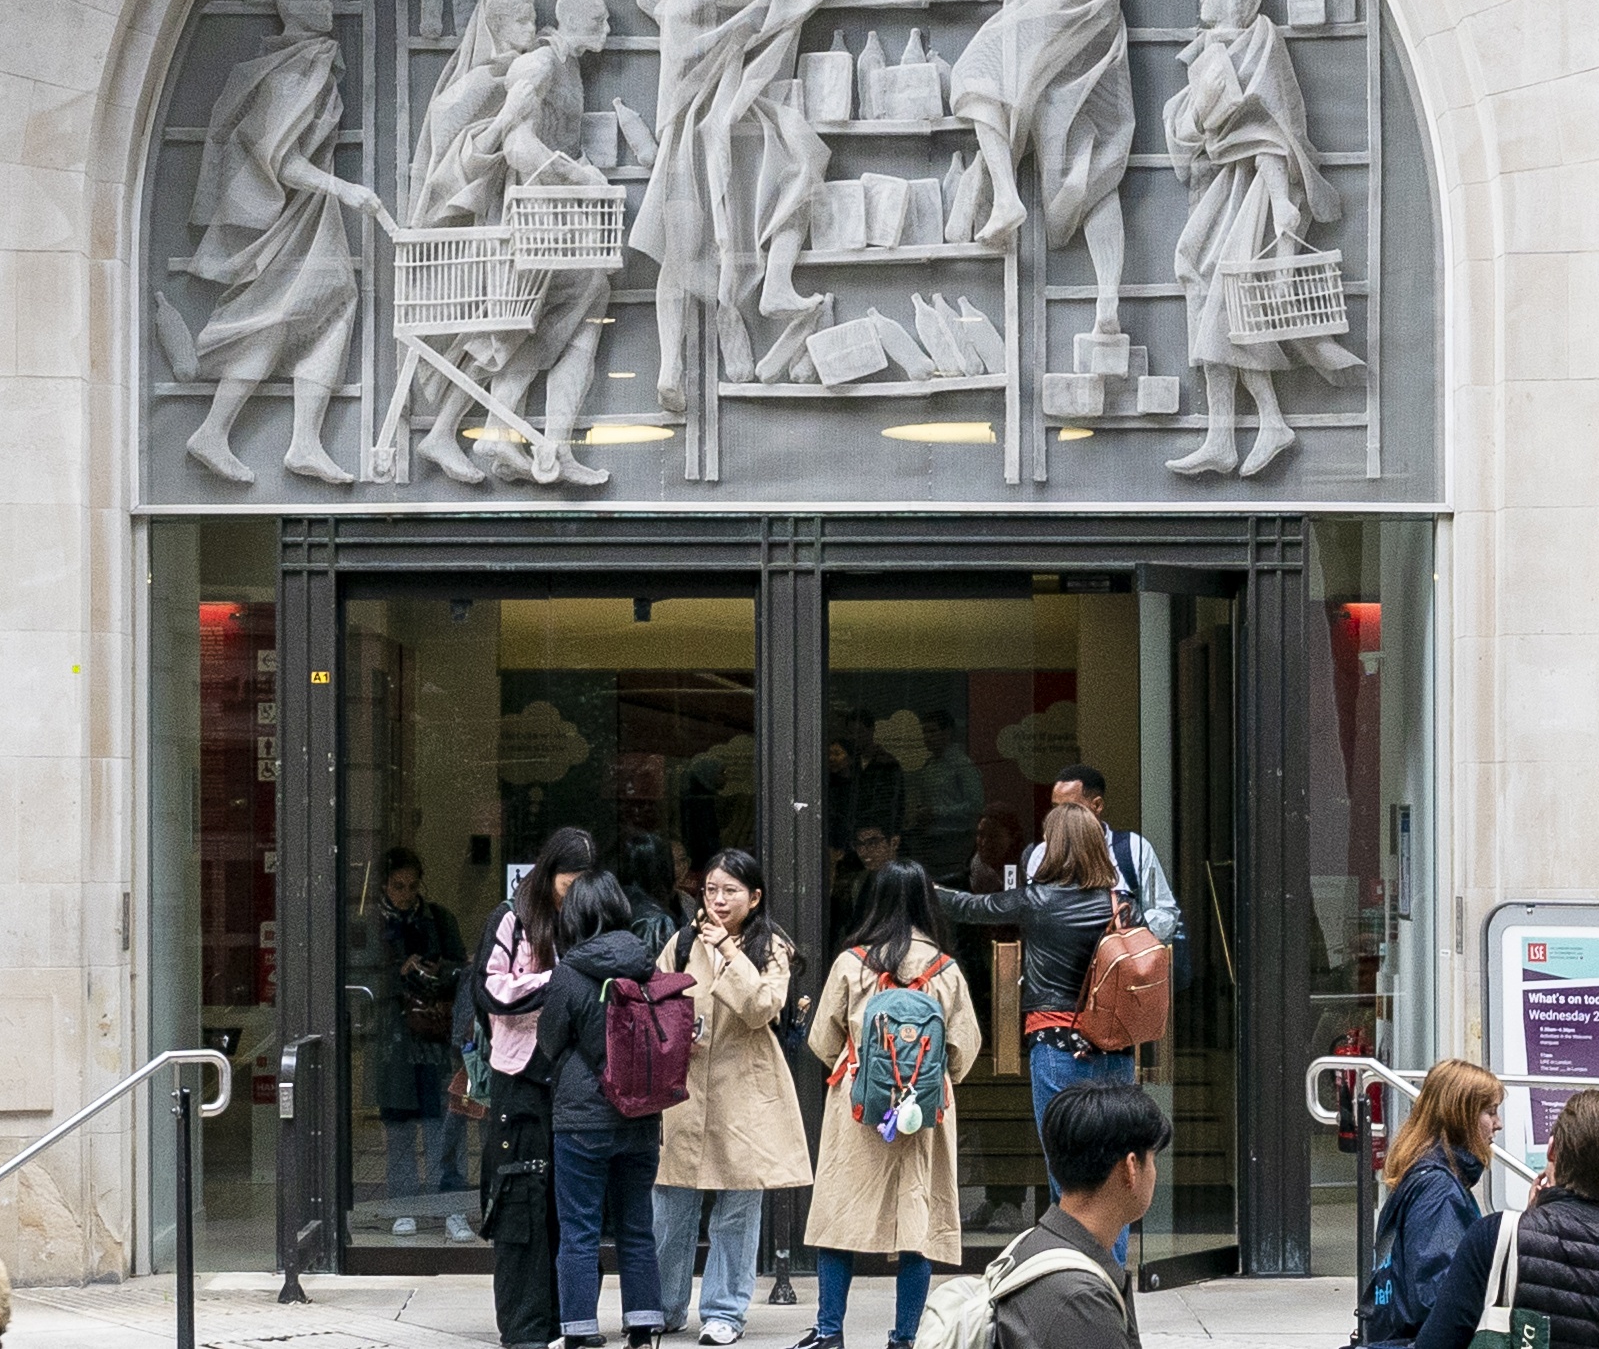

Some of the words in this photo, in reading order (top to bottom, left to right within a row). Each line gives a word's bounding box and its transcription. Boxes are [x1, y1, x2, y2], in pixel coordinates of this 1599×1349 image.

[1529, 944, 1545, 960] LSE
[1528, 992, 1566, 1005] What's
[1569, 995, 1582, 1005] on
[1528, 1009, 1591, 1024] Wednesday
